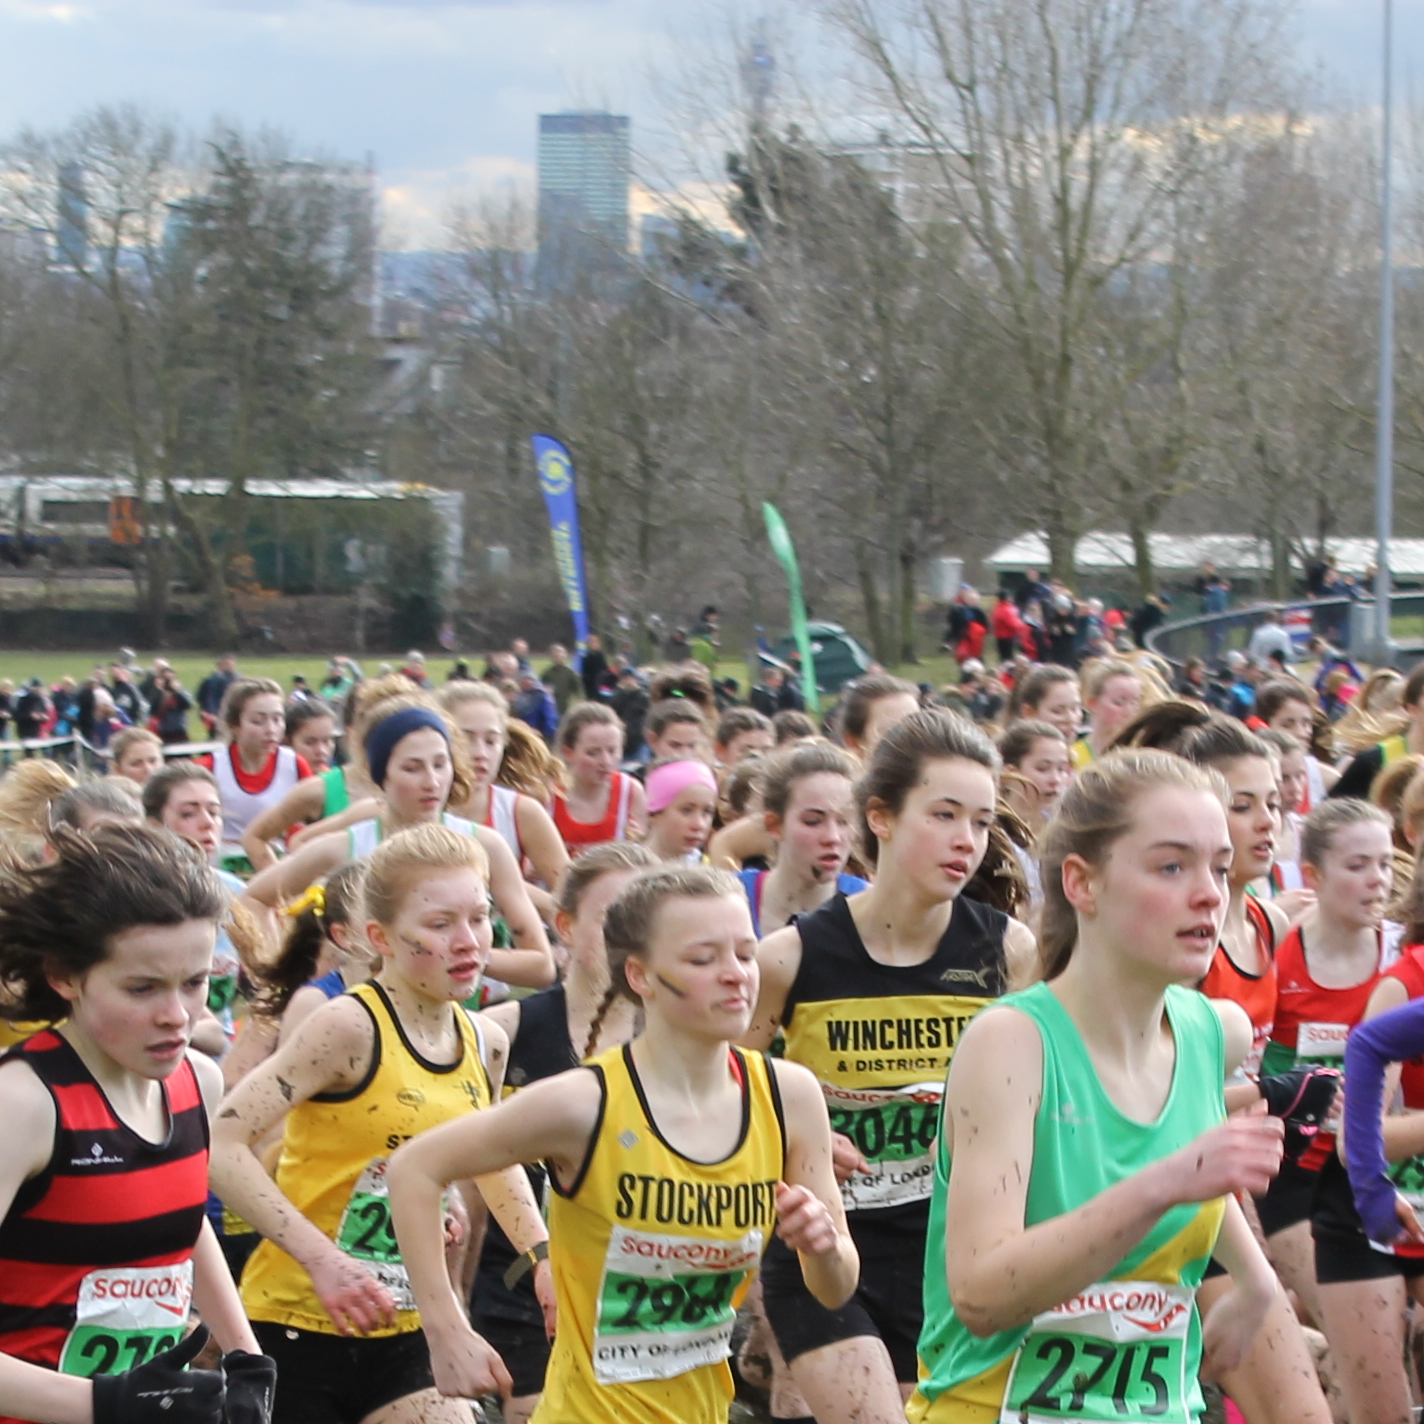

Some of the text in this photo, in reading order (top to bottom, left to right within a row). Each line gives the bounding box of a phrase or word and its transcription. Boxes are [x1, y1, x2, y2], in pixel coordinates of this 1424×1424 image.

[856, 1058, 938, 1072] DISTRICT
[862, 1174, 883, 1188] OF
[616, 1173, 778, 1228] STOCKPORT
[598, 1342, 641, 1361] CITY
[1021, 1338, 1170, 1416] 2715
